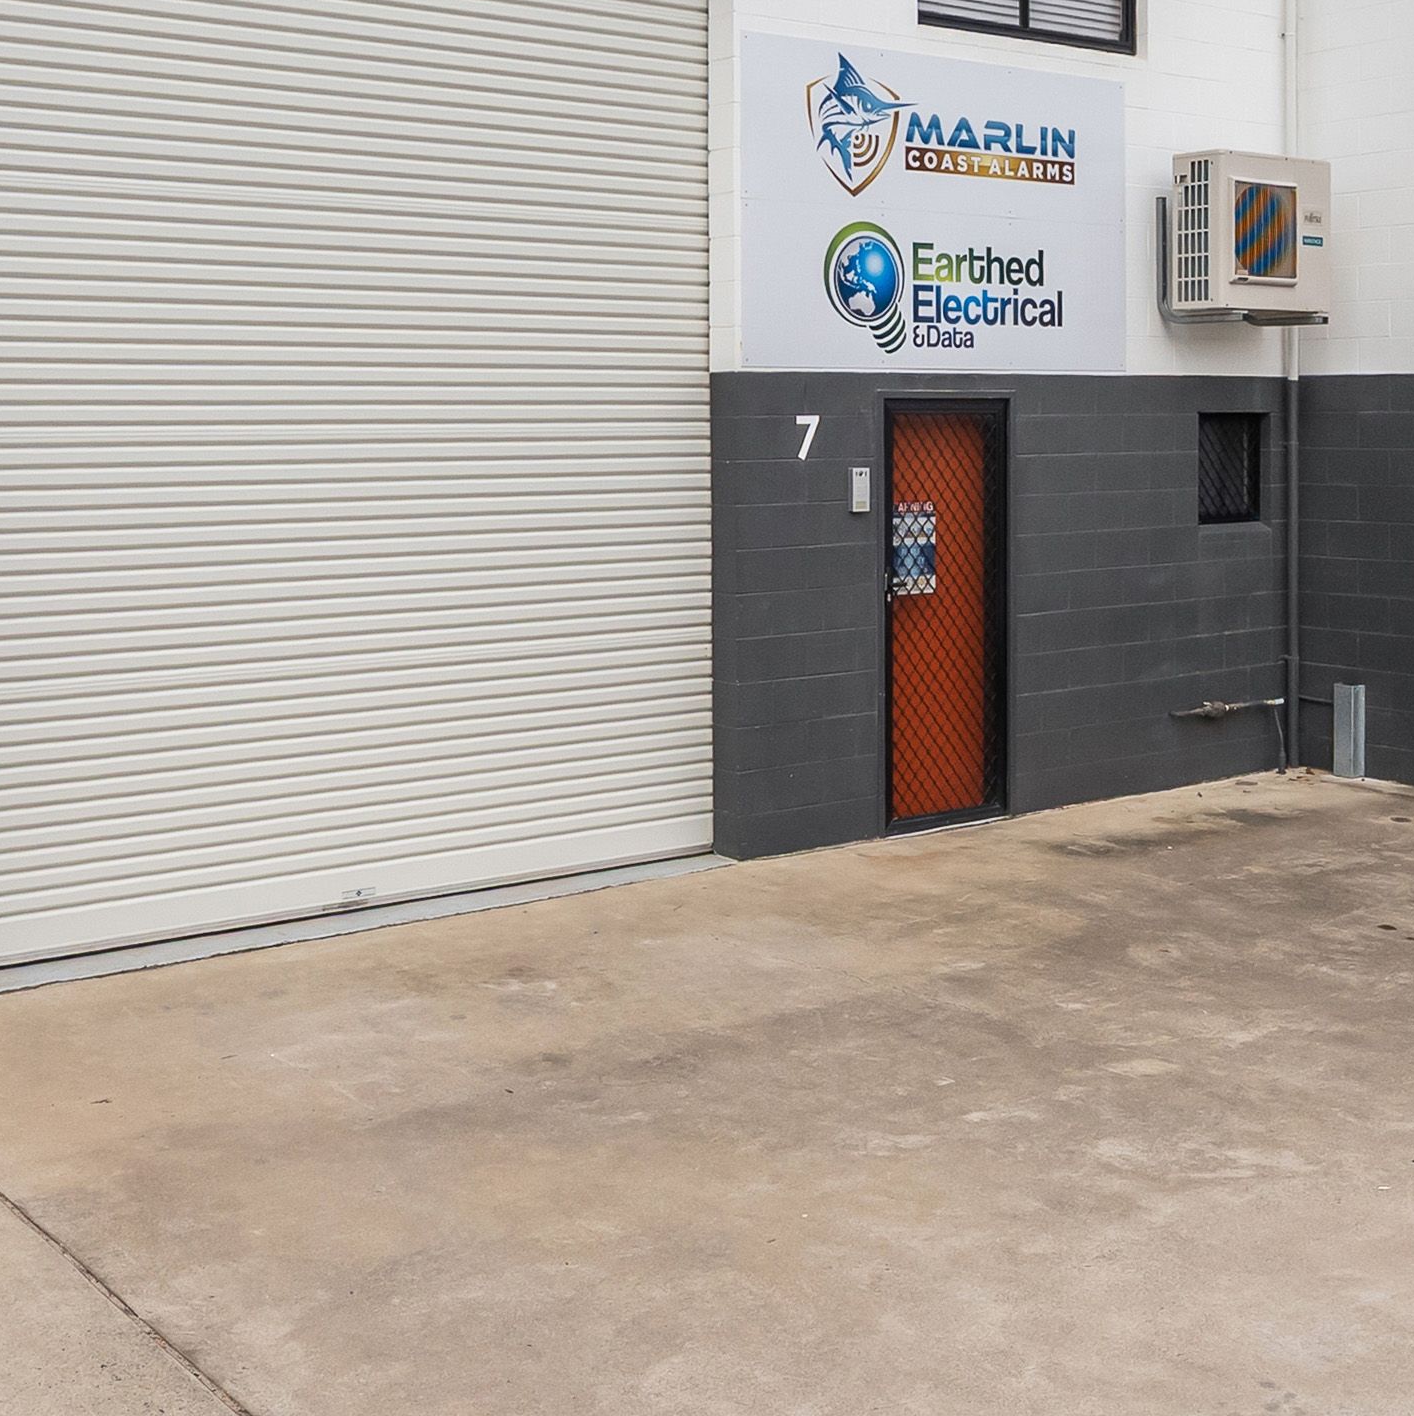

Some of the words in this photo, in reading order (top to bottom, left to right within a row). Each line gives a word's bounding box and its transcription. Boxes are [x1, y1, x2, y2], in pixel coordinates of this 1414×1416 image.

[905, 111, 1076, 159] MARLIN
[907, 149, 982, 172] COAST
[988, 158, 1074, 182] ALARMS
[912, 241, 1044, 286] Earthed
[912, 284, 1063, 327] Electrical
[795, 415, 820, 461] 7
